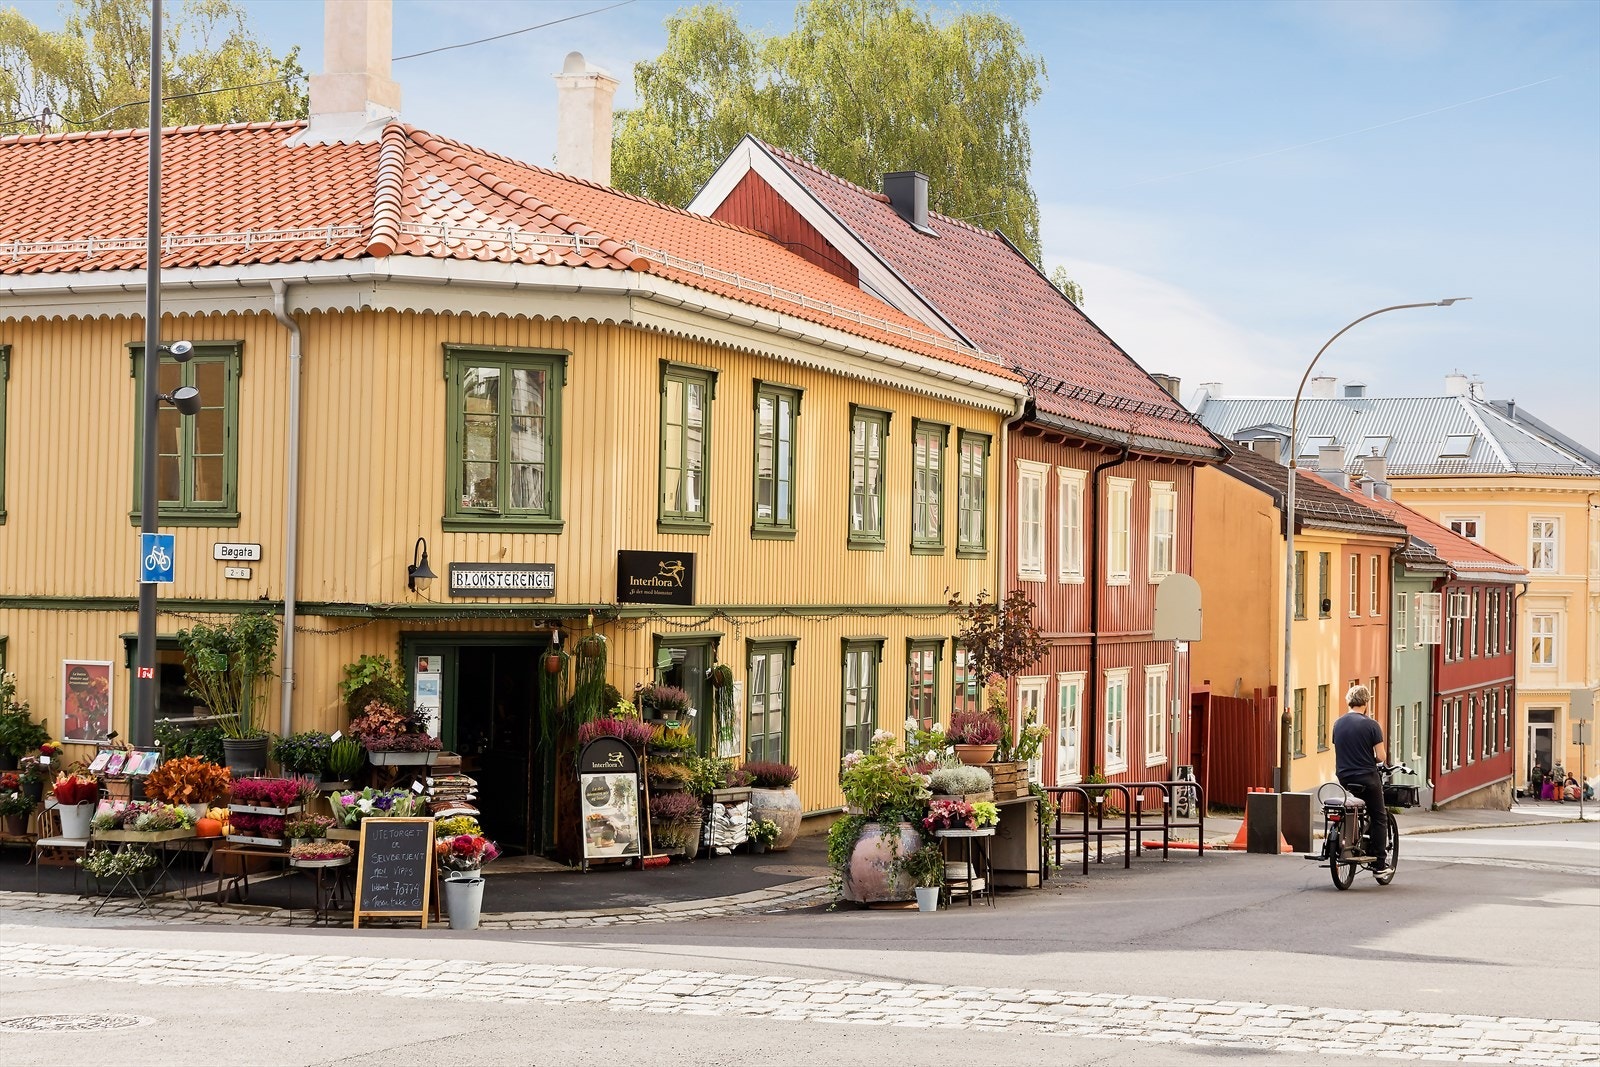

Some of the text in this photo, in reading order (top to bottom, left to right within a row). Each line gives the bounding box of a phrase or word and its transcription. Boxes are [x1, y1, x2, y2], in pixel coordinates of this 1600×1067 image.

[222, 546, 253, 558] Bøgata
[456, 573, 550, 586] BLOMSTERENGA
[629, 575, 673, 587] Interflora
